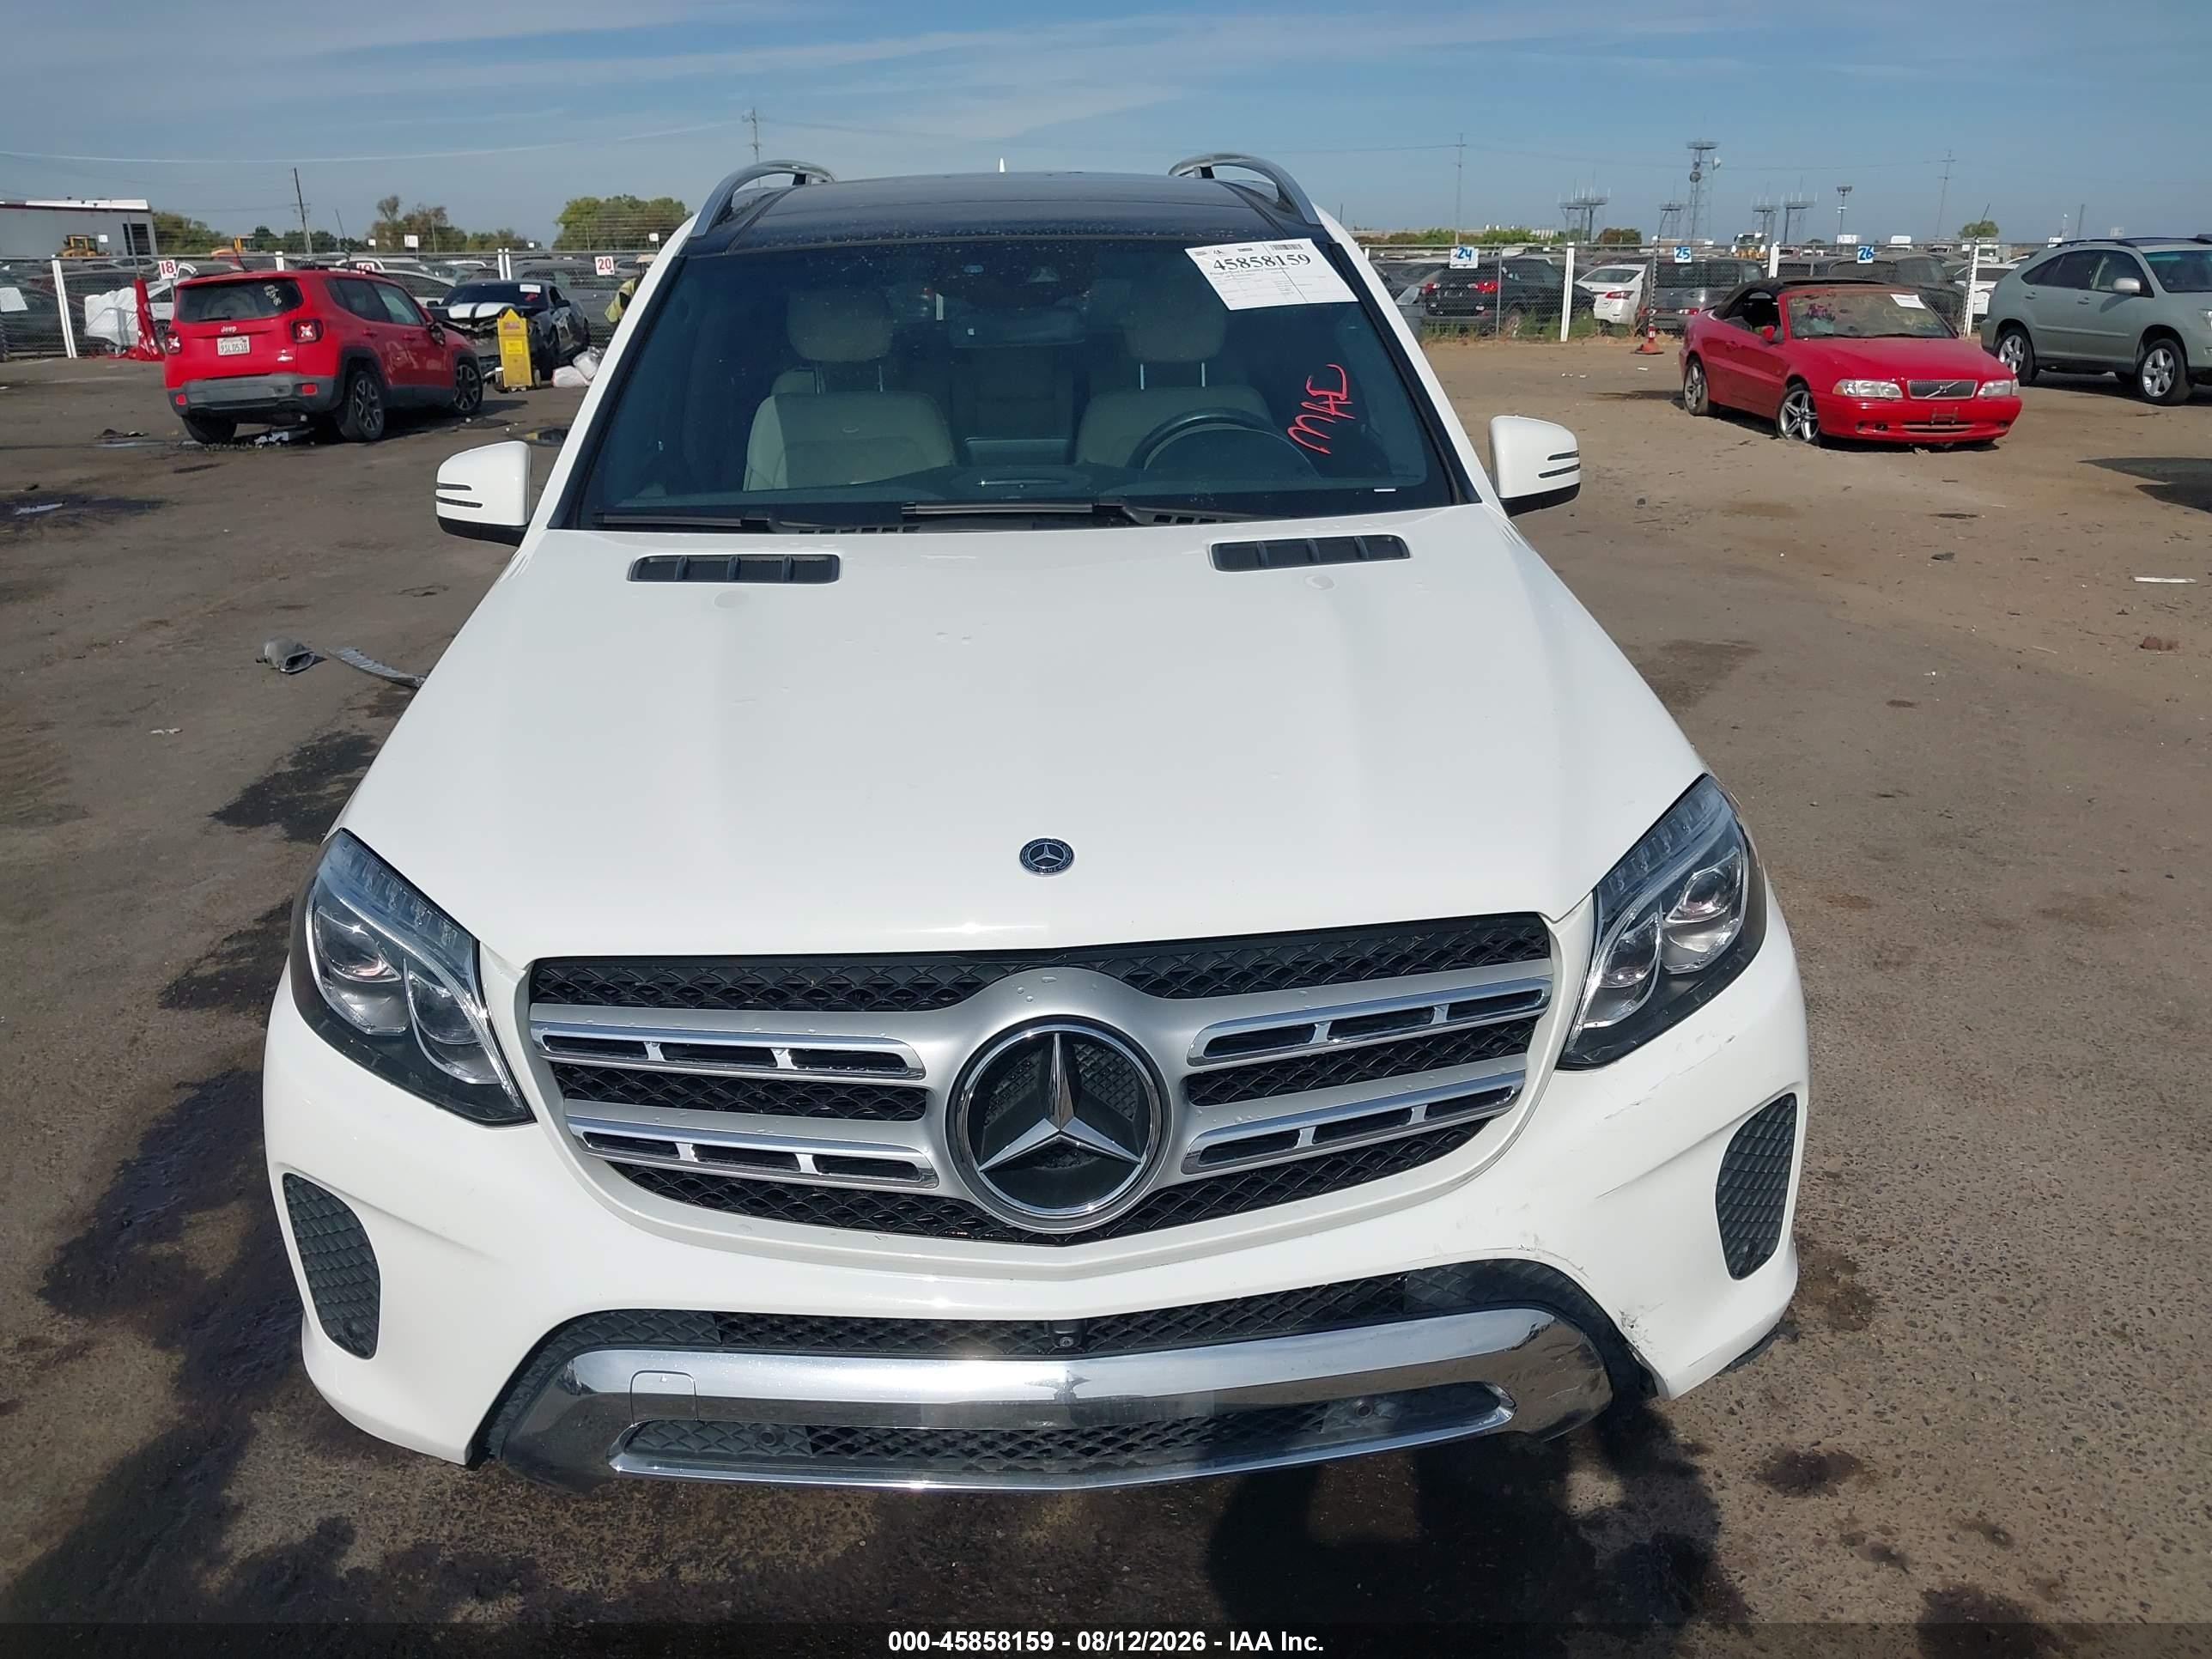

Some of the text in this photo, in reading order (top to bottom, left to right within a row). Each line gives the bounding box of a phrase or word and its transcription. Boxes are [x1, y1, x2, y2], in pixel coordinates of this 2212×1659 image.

[1457, 247, 1473, 261] 24
[1675, 246, 1690, 259] 25
[1858, 246, 1874, 260] 26
[161, 261, 174, 274] 18
[598, 258, 611, 270] 20
[1213, 254, 1311, 271] 45858159
